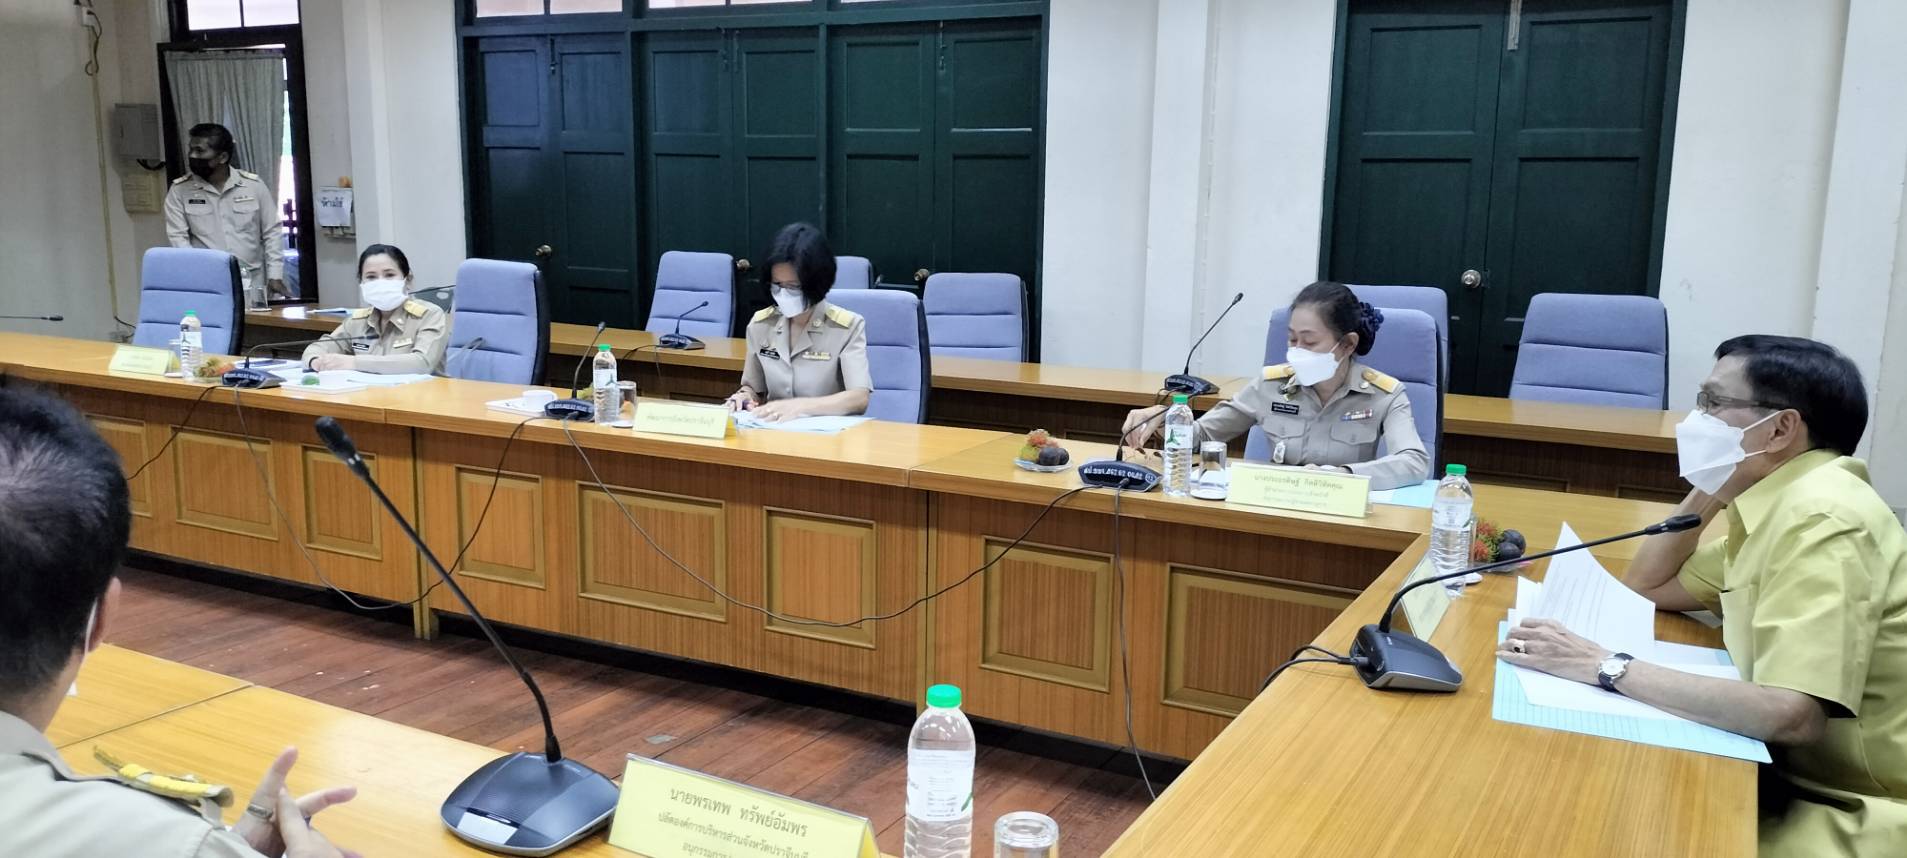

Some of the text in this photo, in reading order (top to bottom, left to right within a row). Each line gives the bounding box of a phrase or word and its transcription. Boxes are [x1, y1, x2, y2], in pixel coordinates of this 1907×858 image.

[657, 811, 810, 858] ปลัดองค์การบริหารส่วนจังหวัดปราจีนบรี
[670, 788, 809, 838] นายพรเทพ ทรัพย์อัมพร
